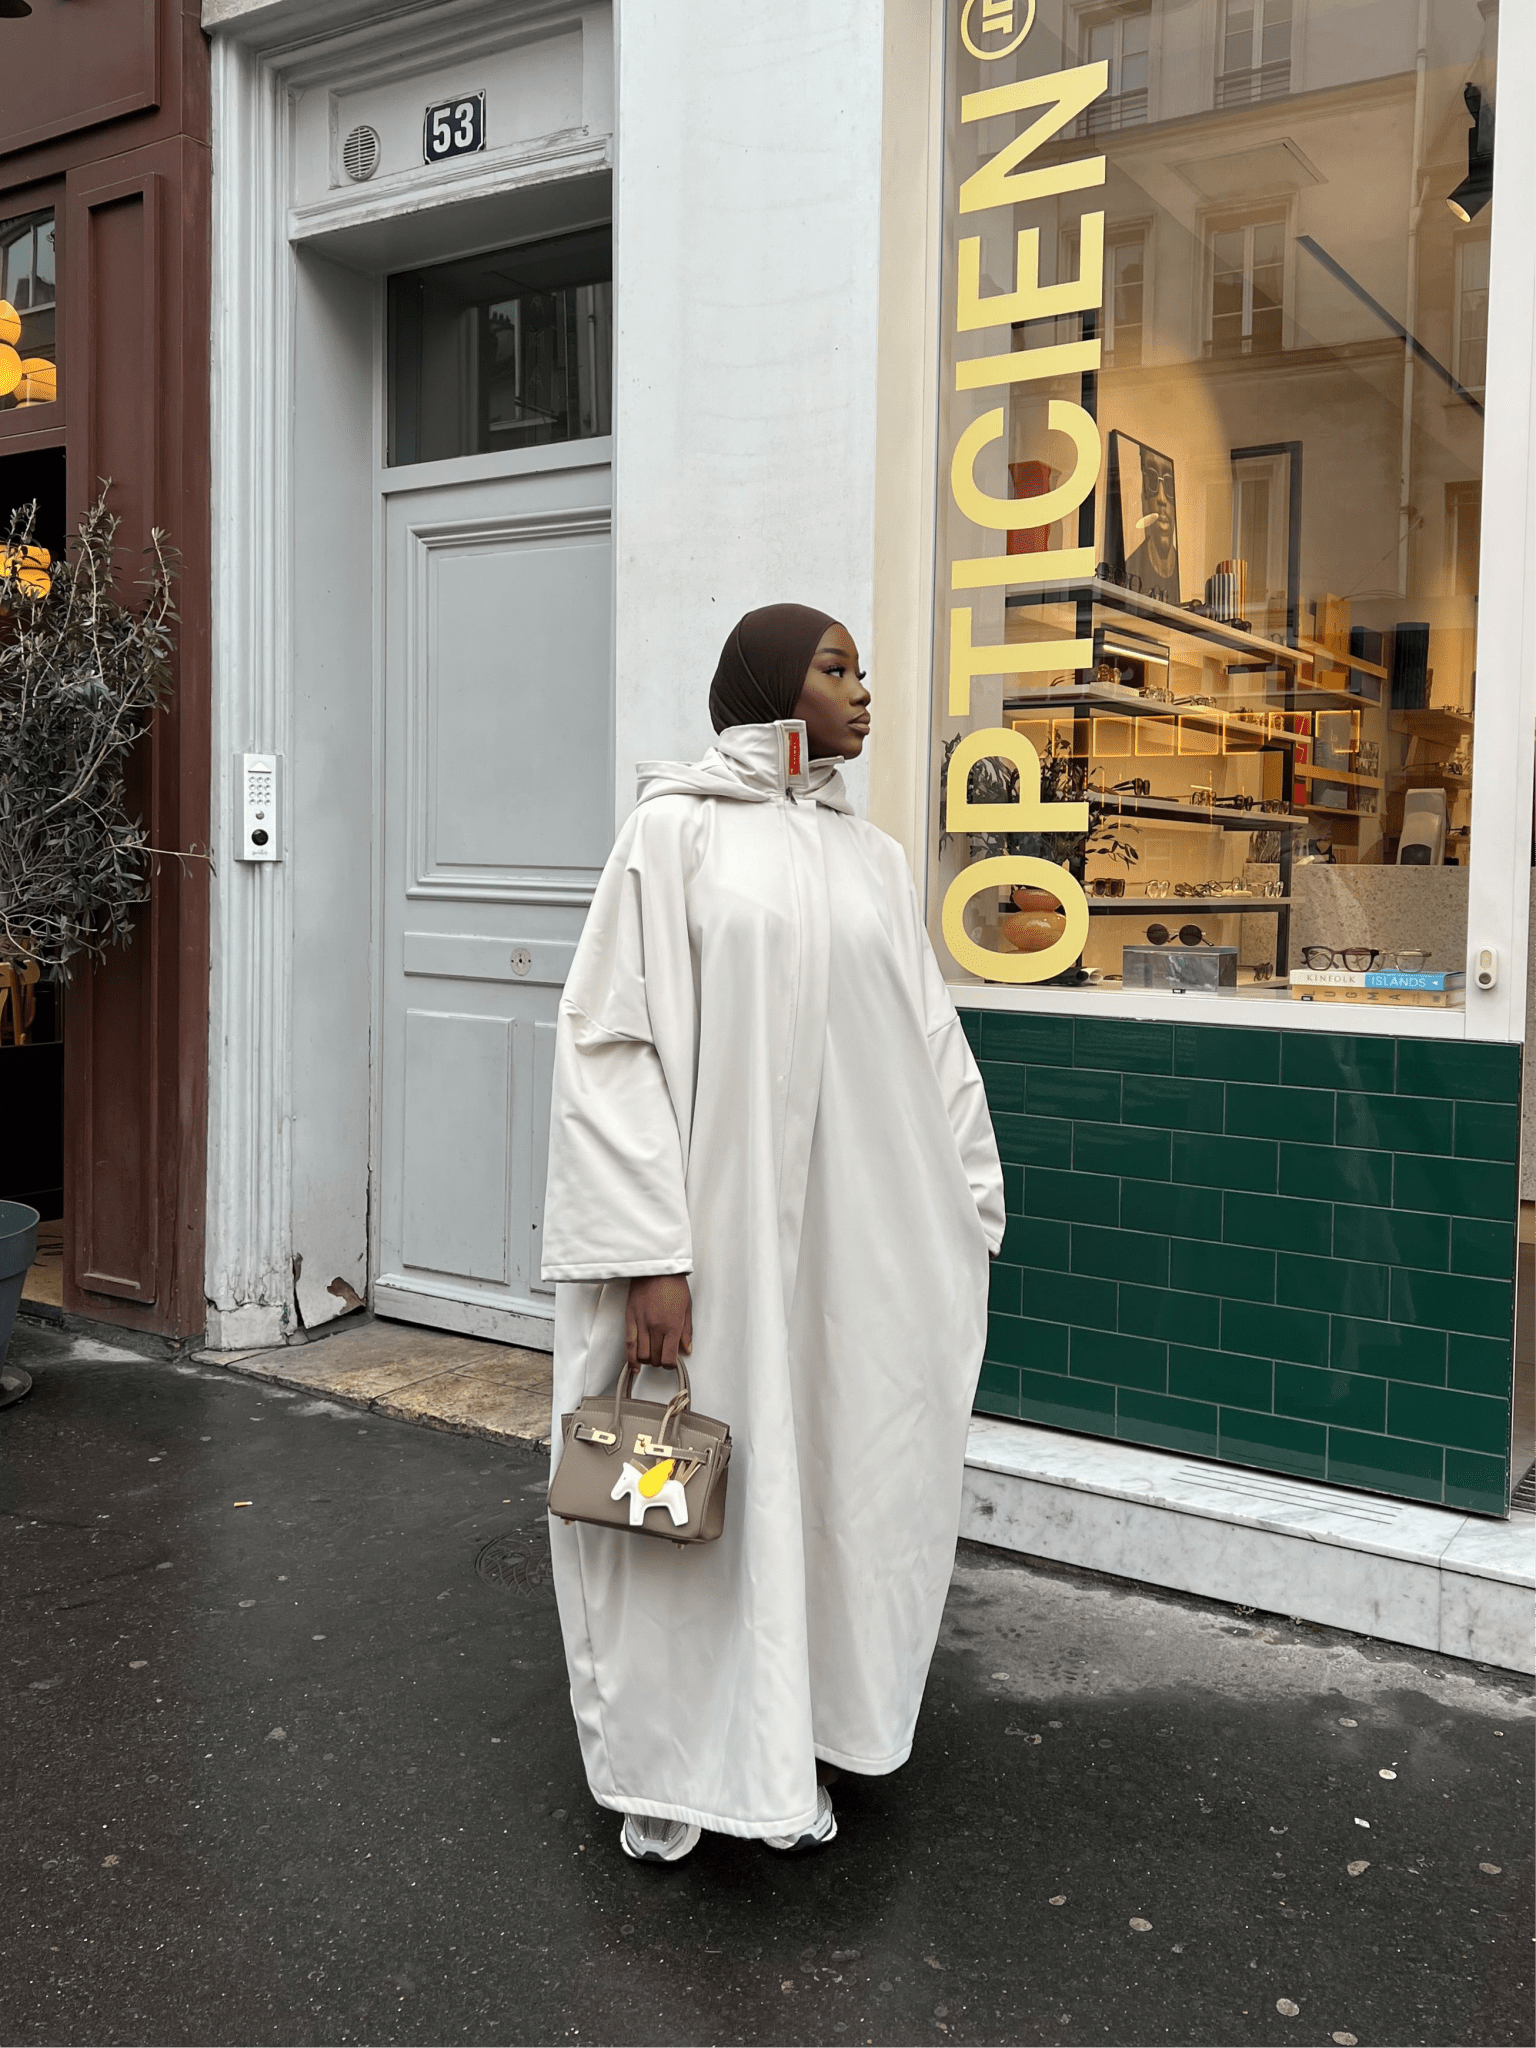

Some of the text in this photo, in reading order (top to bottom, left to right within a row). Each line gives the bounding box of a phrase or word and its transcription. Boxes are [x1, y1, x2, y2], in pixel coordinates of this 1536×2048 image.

[432, 102, 475, 153] 53
[941, 60, 1109, 984] OPTICIEN
[1306, 975, 1427, 987] KINFOLK ISLANDS
